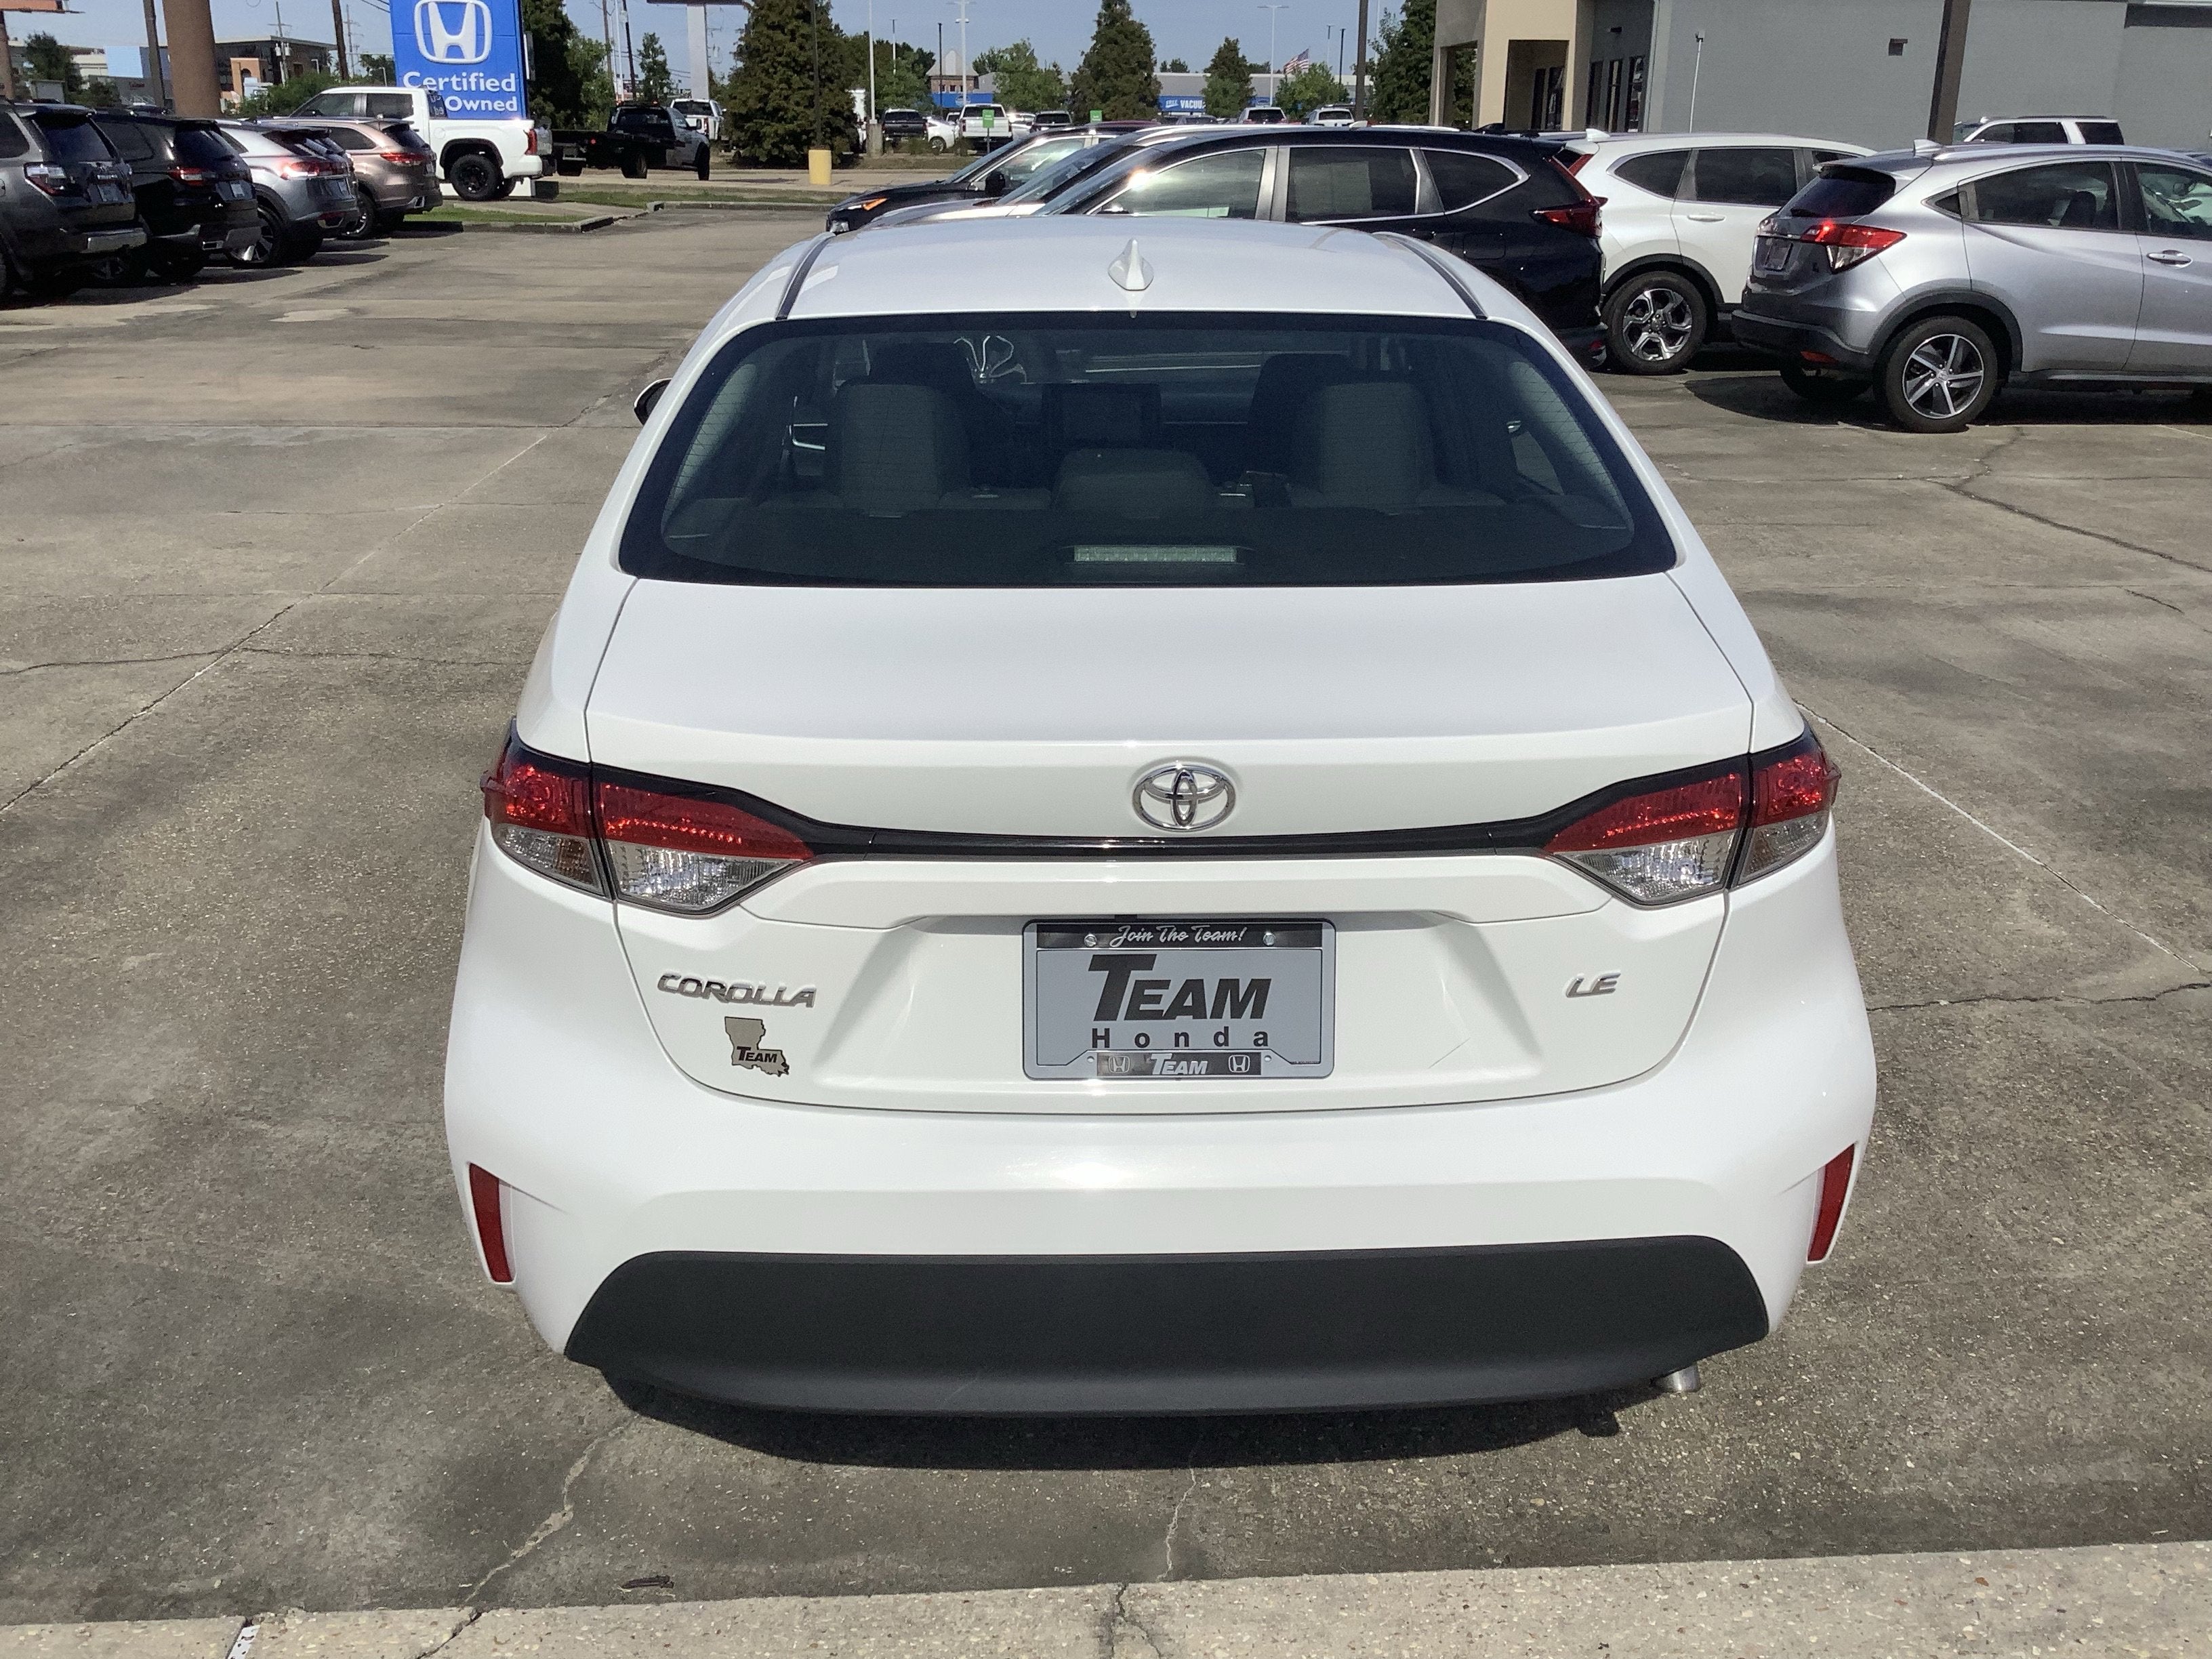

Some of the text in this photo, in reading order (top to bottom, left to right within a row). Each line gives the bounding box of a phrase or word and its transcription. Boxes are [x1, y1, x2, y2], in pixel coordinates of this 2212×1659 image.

[403, 71, 516, 92] Certified
[445, 96, 518, 112] Owned
[1109, 925, 1248, 947] Join The Team!
[657, 974, 817, 1008] COROLLA
[1088, 954, 1271, 1021] TEAM
[1565, 972, 1621, 998] LE
[1091, 1026, 1269, 1048] Honda
[736, 1046, 777, 1063] TEAM
[1151, 1053, 1208, 1076] TEAM
